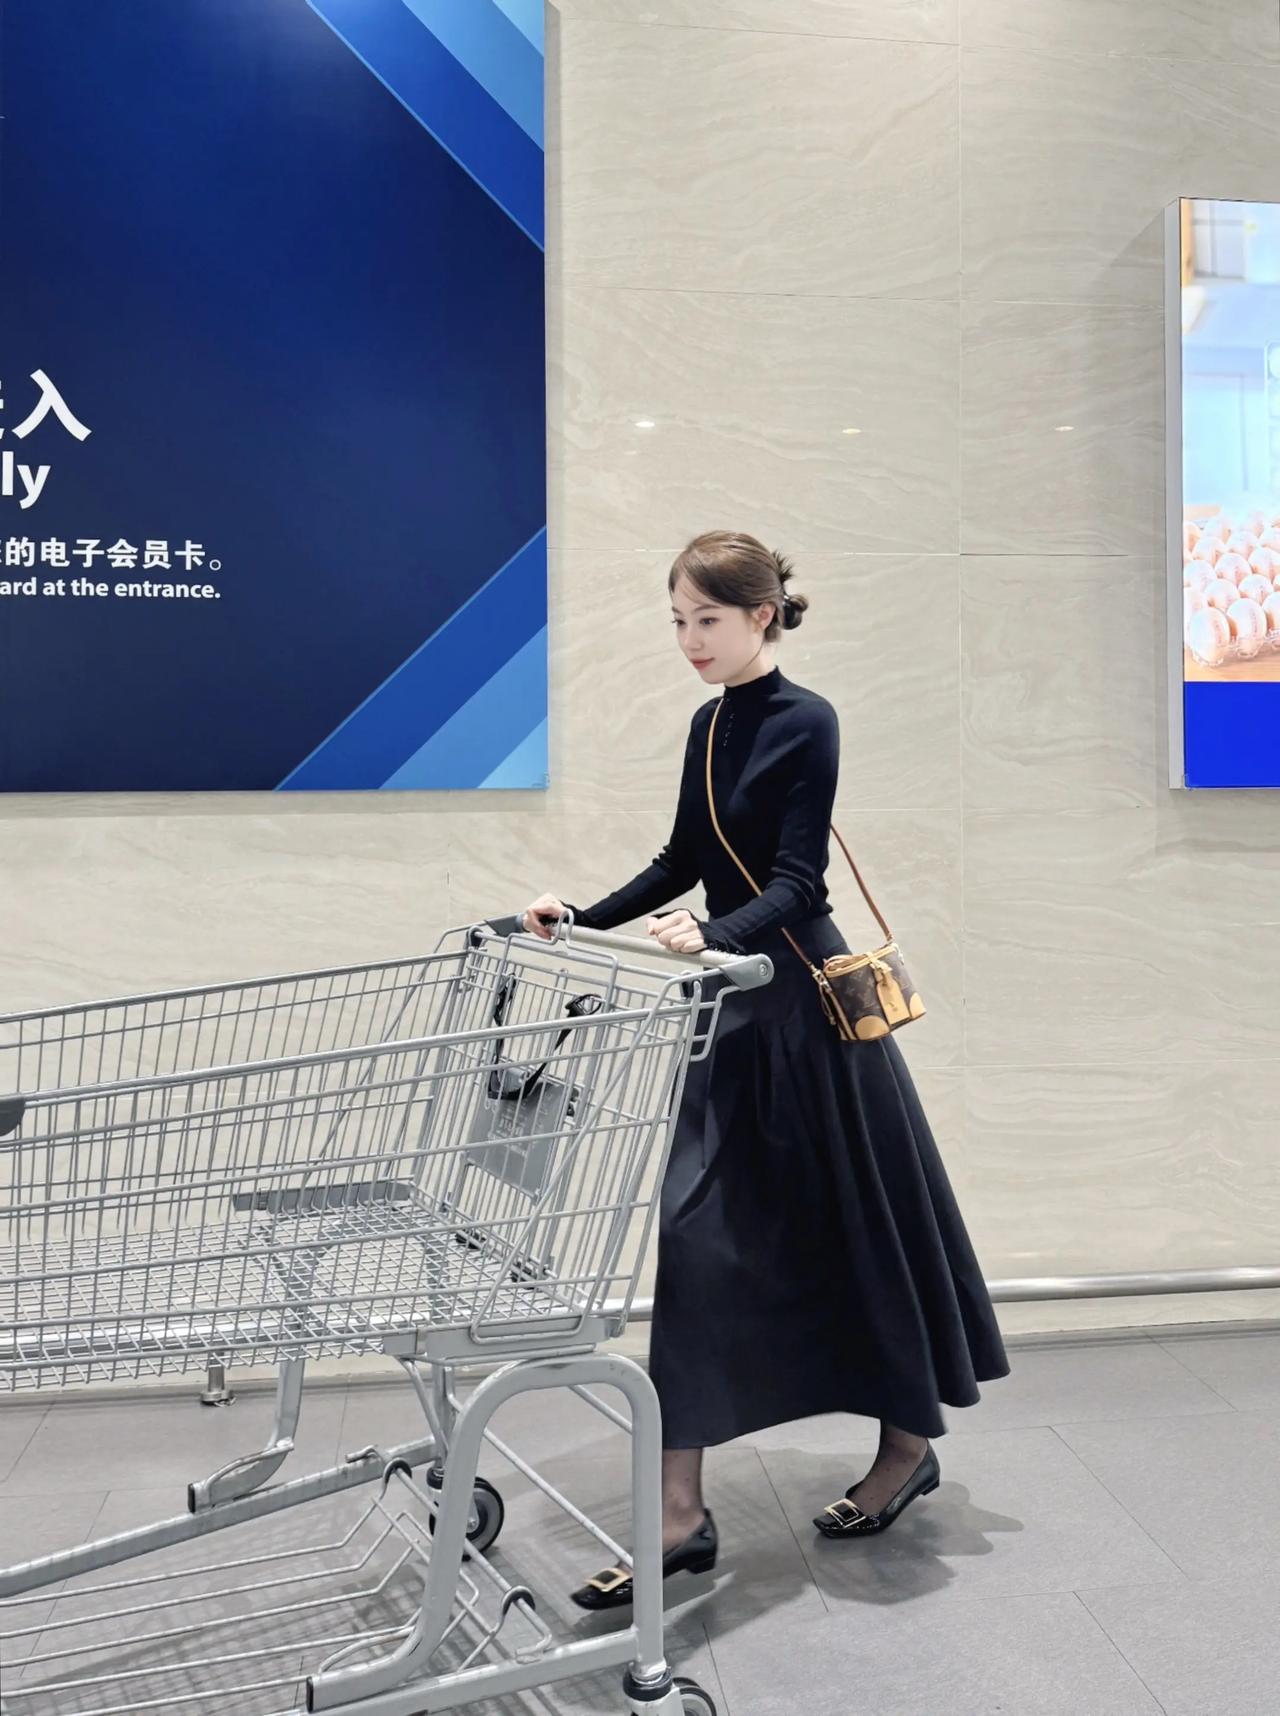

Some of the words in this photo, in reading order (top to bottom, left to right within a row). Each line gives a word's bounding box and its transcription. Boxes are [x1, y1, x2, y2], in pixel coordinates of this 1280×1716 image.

[0, 369, 92, 442] 入
[2, 450, 51, 510] ly
[0, 536, 222, 571] 的电子会员卡。
[0, 576, 37, 596] ard
[42, 579, 66, 597] at
[70, 577, 109, 597] the
[114, 580, 221, 599] entrance.
